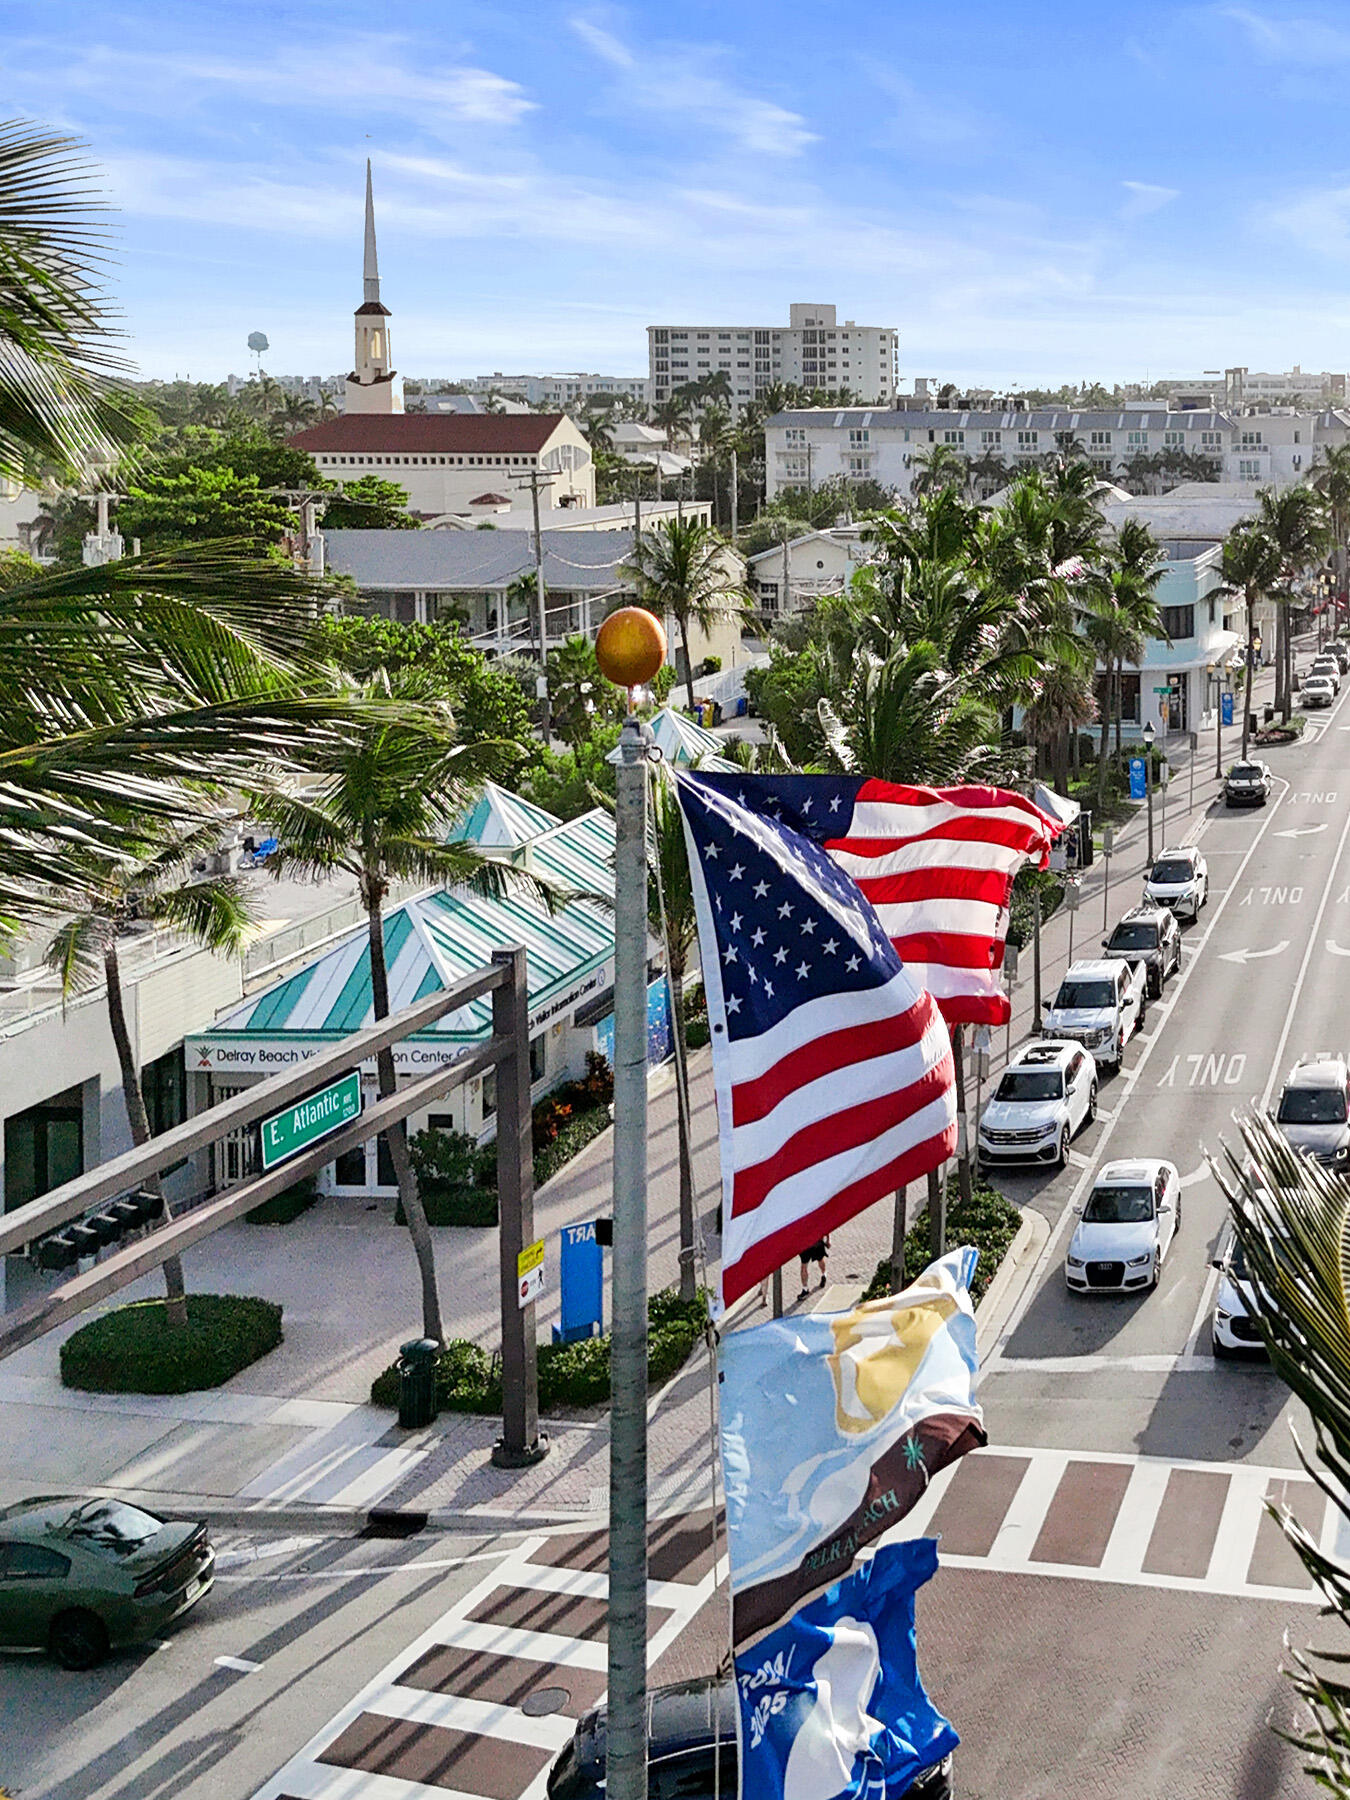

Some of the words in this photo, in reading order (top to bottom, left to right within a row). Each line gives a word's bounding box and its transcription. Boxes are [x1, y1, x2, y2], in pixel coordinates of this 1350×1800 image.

[1287, 791, 1337, 804] ONLY
[1239, 886, 1304, 906] ONLY
[217, 1049, 256, 1064] Delray
[259, 1049, 298, 1062] Beach
[411, 1049, 453, 1063] Center
[1156, 1053, 1247, 1087] ONLY
[270, 1121, 284, 1146] E.
[293, 1091, 339, 1134] Atlantic
